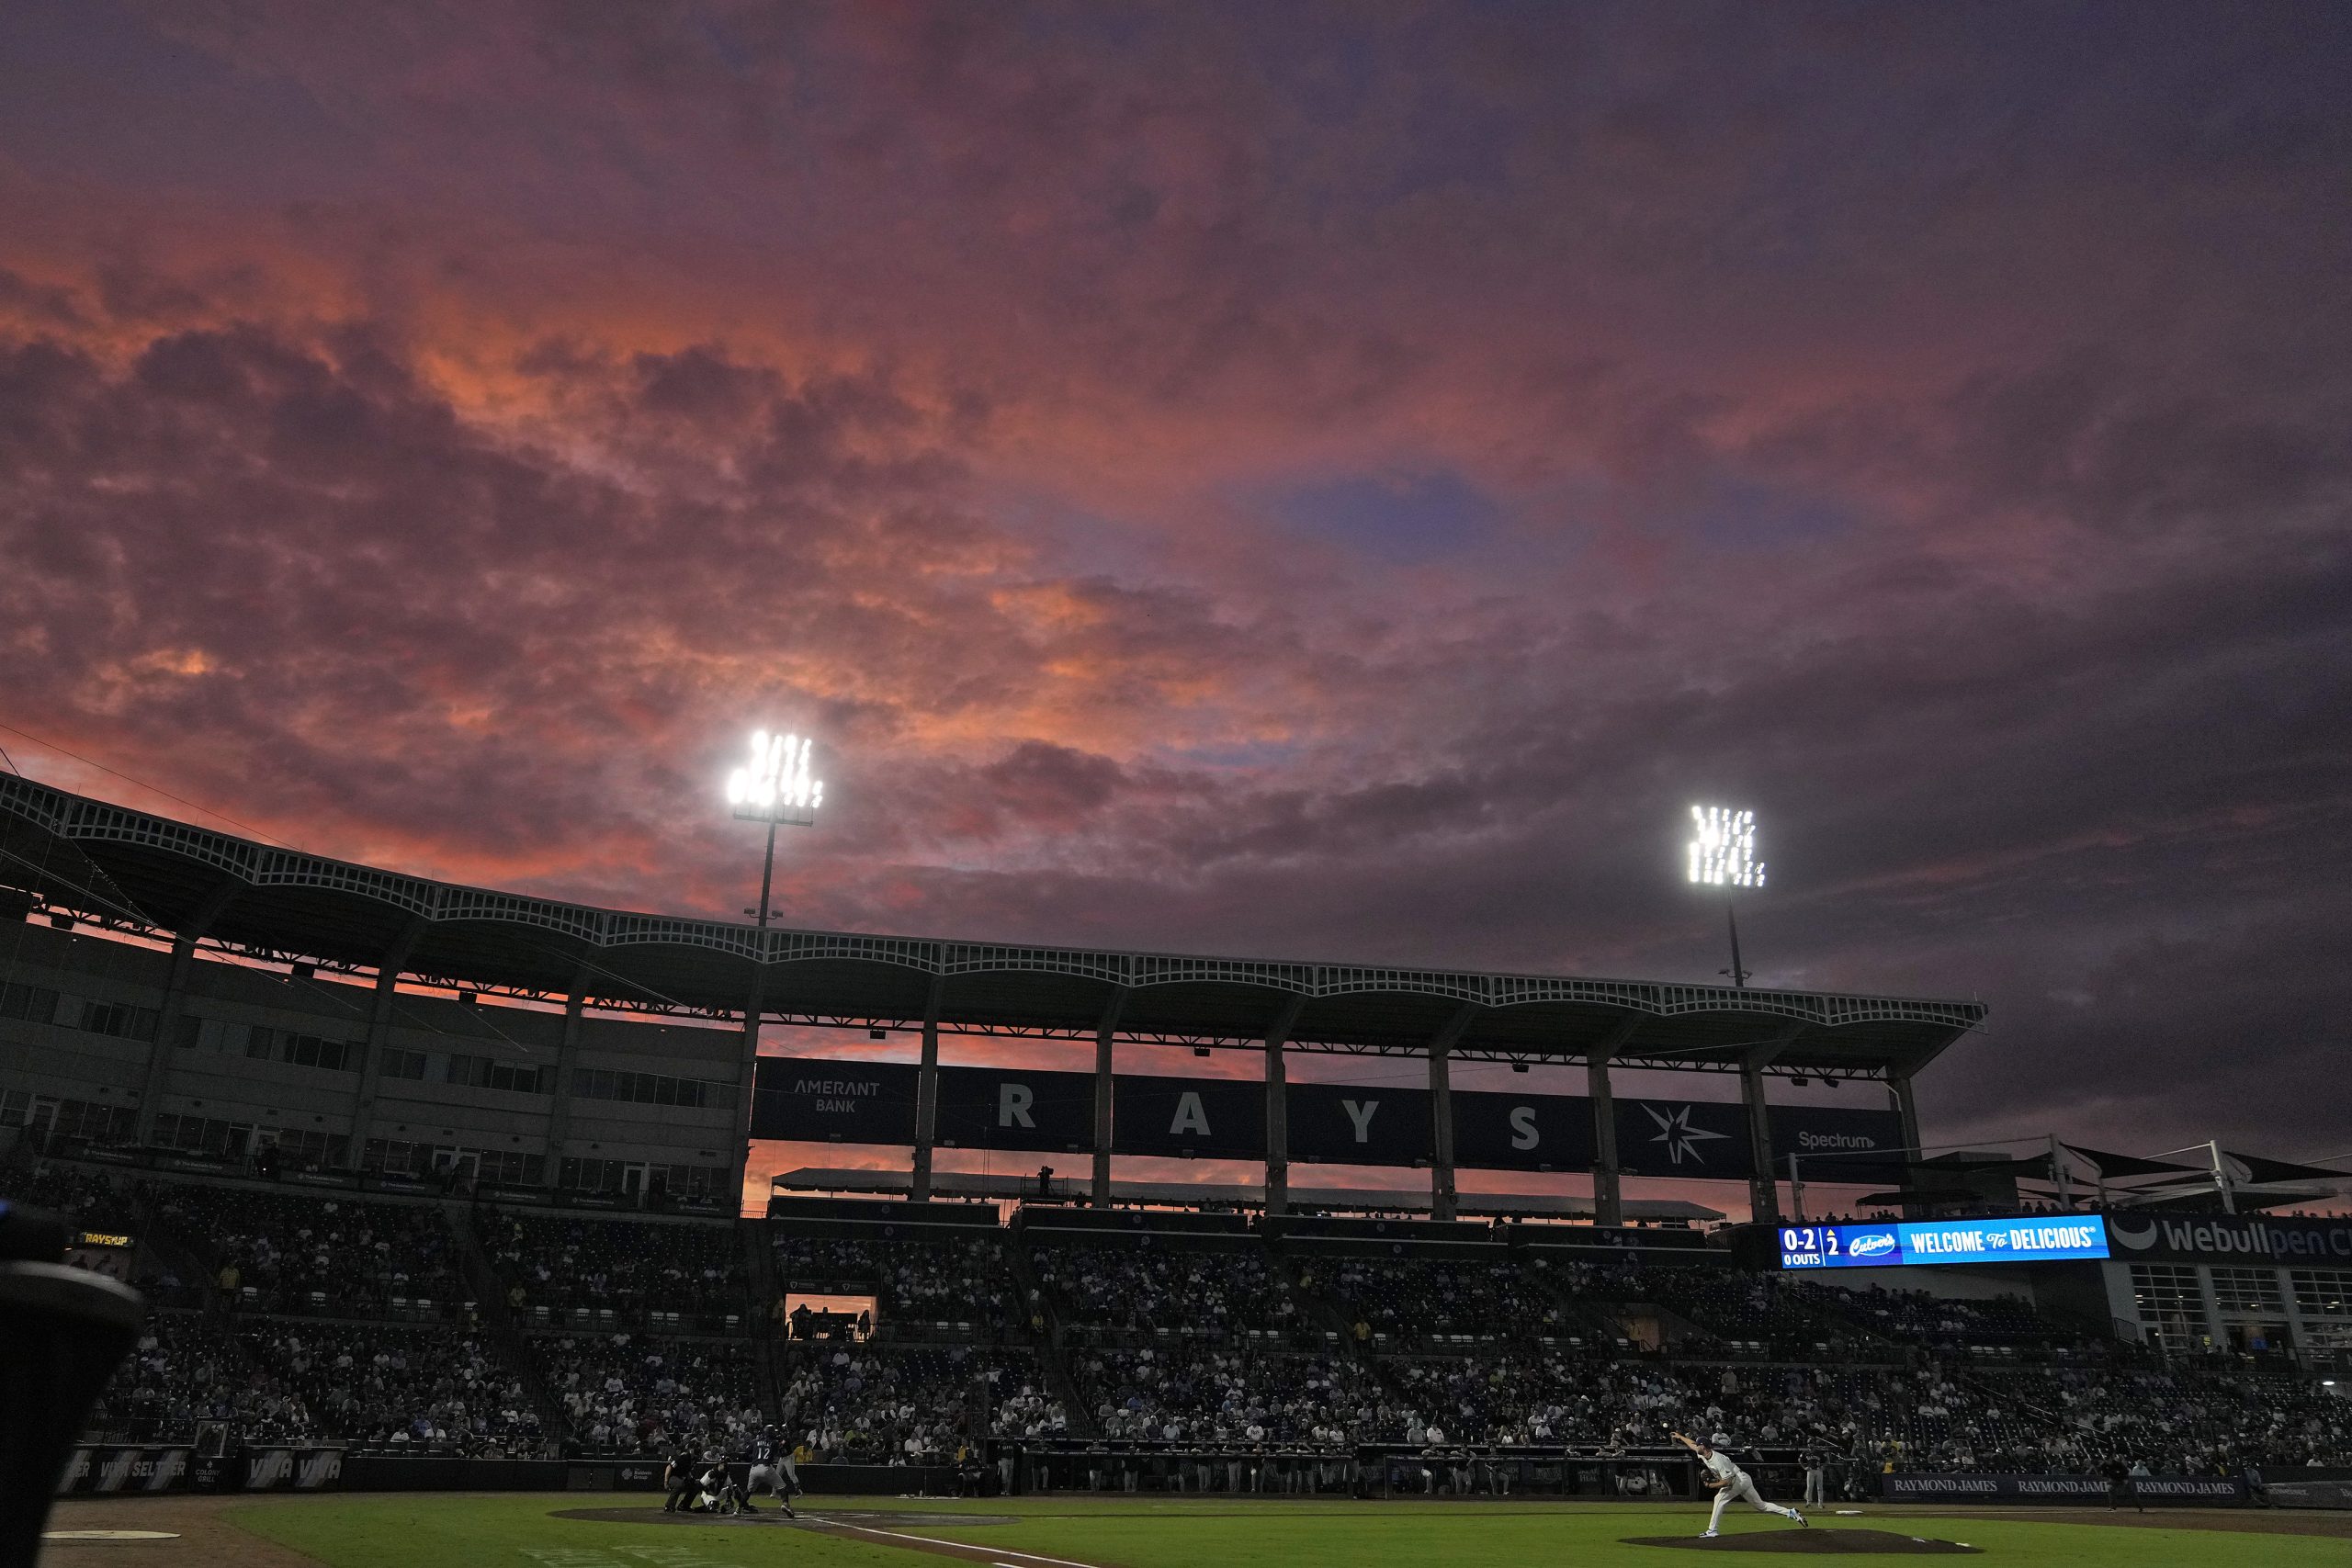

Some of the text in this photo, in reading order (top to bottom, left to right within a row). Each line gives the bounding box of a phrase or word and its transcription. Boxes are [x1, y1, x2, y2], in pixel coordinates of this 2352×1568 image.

[794, 1079, 880, 1096] AMERANT
[816, 1099, 855, 1112] BANK
[1798, 1131, 1873, 1150] Spectrum
[1783, 1229, 1816, 1251] 0-2
[1826, 1236, 1839, 1256] 2
[1849, 1233, 1895, 1257] Culver's
[1910, 1231, 1985, 1254] WELCOME
[1986, 1233, 2007, 1249] To
[1784, 1253, 1821, 1266] 0 OUTS
[757, 1448, 770, 1460] 12
[251, 1458, 293, 1479] VIVA
[300, 1459, 342, 1479] VIVA
[1894, 1480, 1997, 1492] RAYMOND JAMES
[2018, 1481, 2079, 1492] RAYMOND
[2136, 1483, 2235, 1495] RAYMOND JAMES
